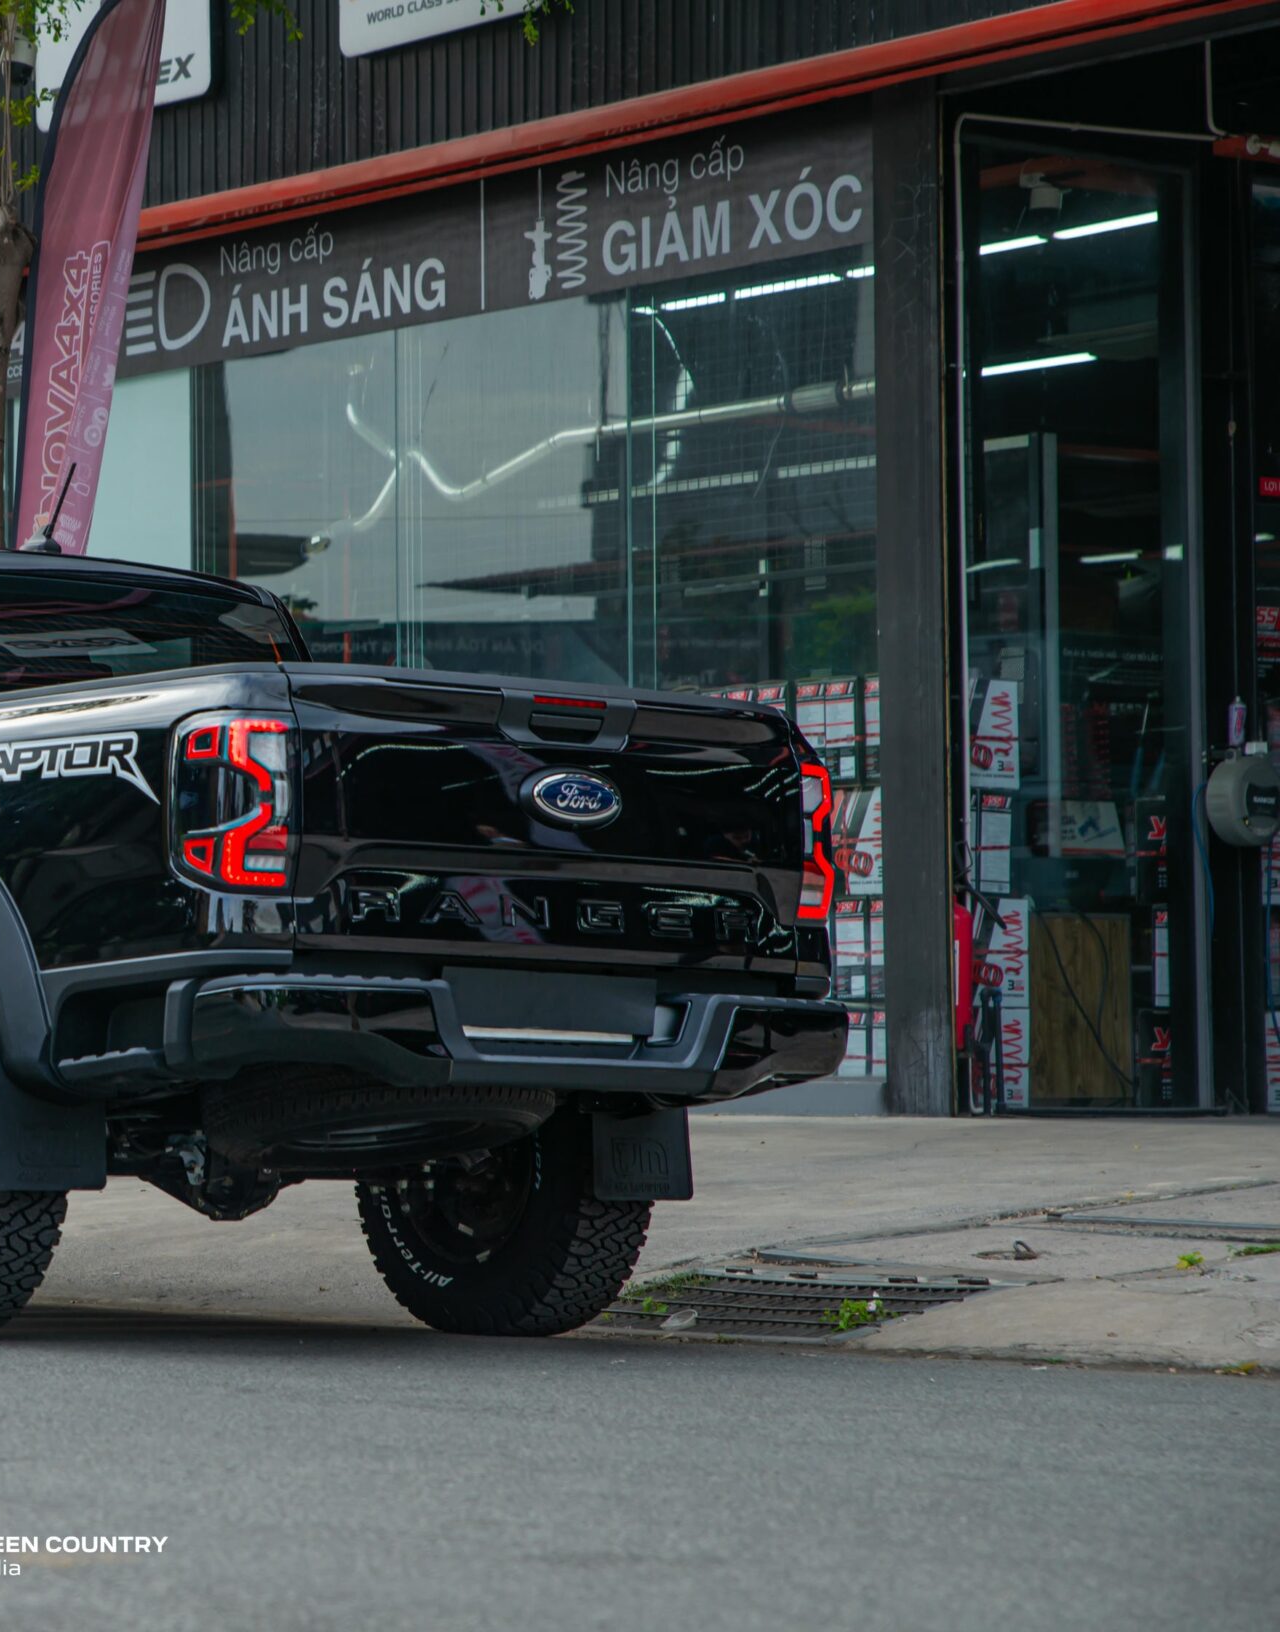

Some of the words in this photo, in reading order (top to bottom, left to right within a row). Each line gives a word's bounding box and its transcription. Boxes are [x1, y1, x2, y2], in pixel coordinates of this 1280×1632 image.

[366, 5, 404, 24] WORLD
[605, 158, 679, 198] Nâng
[690, 134, 744, 182] cấp
[221, 241, 281, 275] Nâng
[289, 222, 334, 265] cấp
[602, 196, 730, 276] GIẢM
[748, 166, 862, 249] XÓC
[222, 284, 308, 348] ÁNH
[322, 257, 446, 329] SÁNG
[556, 782, 602, 810] Ford
[349, 886, 758, 943] RANGER
